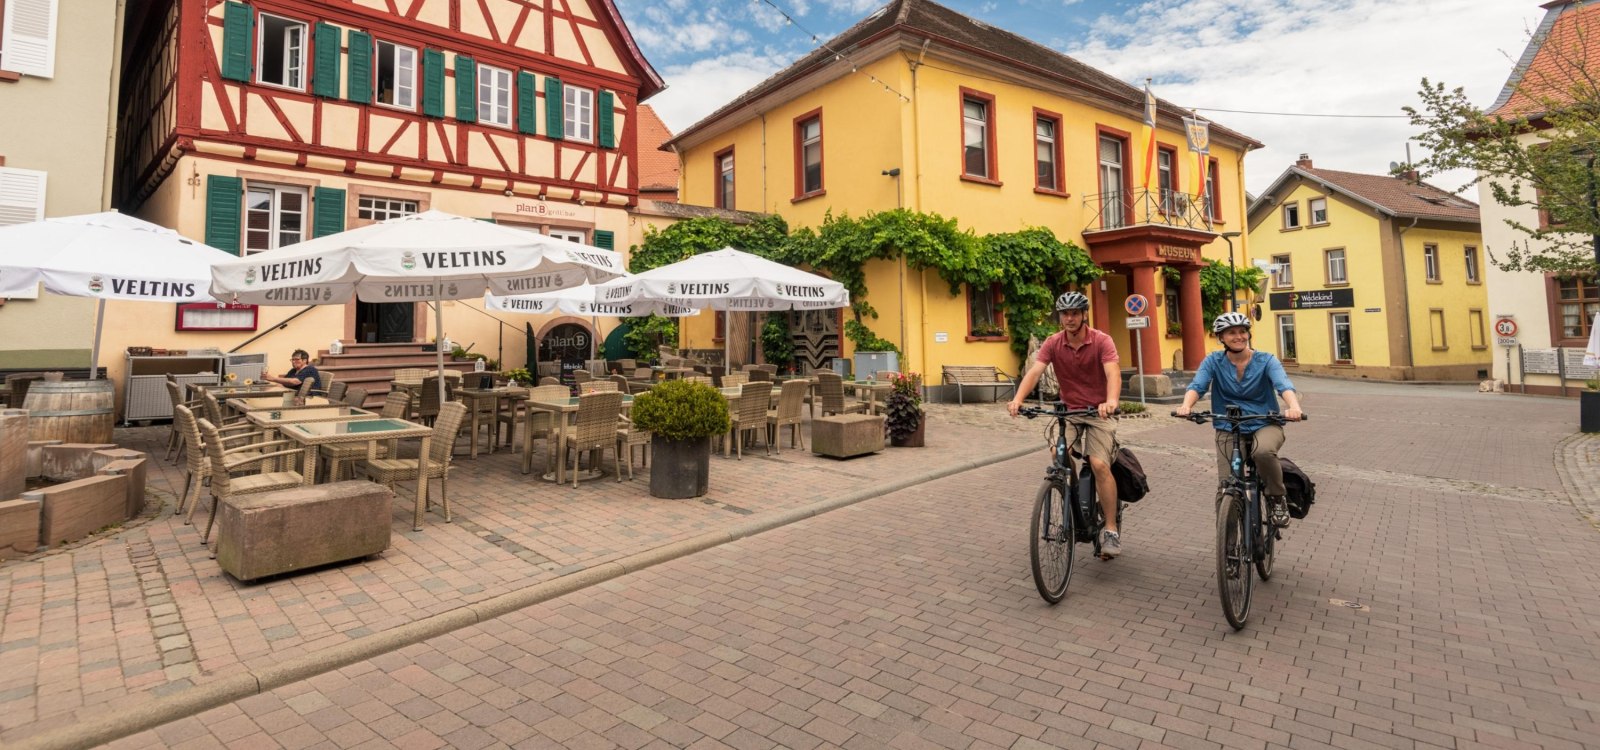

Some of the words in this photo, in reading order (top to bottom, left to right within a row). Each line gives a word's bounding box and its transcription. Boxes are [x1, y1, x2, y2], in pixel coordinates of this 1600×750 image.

[1159, 244, 1197, 259] MUSEUM
[422, 250, 506, 269] VELTINS
[261, 257, 322, 282] VELTINS
[111, 278, 196, 297] VELTINS
[680, 283, 730, 295] VELTINS
[786, 285, 825, 297] VELTINS
[1301, 291, 1332, 301] Wedekind
[511, 299, 543, 310] VELTINS
